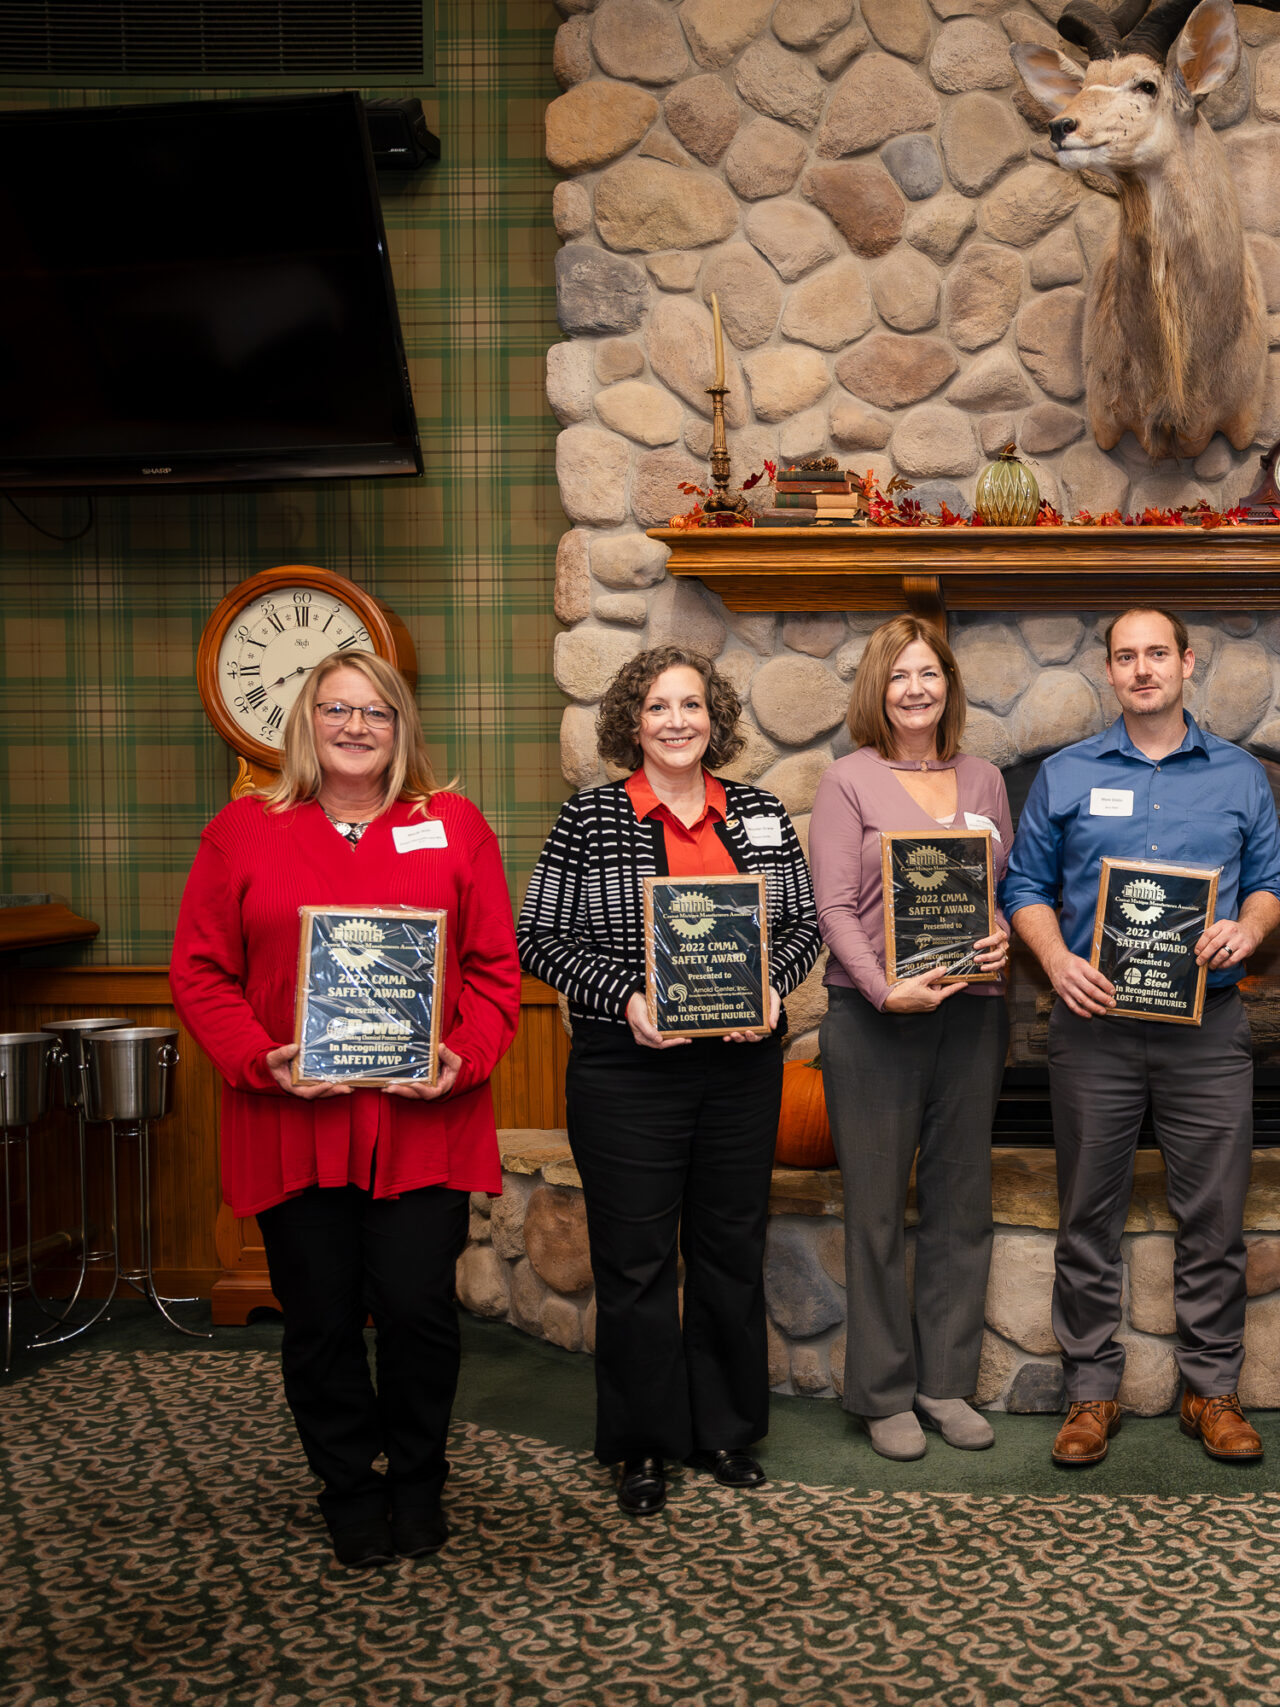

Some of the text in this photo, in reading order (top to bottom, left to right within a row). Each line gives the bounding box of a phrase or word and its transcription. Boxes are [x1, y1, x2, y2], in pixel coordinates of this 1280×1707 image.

[293, 592, 312, 604] 60
[260, 600, 275, 616] 55
[332, 603, 342, 613] 5
[234, 625, 249, 643] 50
[356, 627, 371, 642] 10
[227, 661, 238, 680] 45
[233, 696, 249, 714] 40
[259, 726, 275, 741] 35
[915, 893, 968, 904] 2022 CMMA
[909, 905, 976, 916] SAFETY AWARD
[923, 922, 954, 930] Presented
[1126, 927, 1181, 941] 2022 CMMA
[679, 941, 738, 952] 2022 CMMA
[1116, 938, 1187, 954] SAFETY AWARD
[671, 953, 747, 965] SAFETY AWARD
[1129, 956, 1161, 967] Presented
[338, 973, 407, 985] 2022 CMMA
[1144, 969, 1167, 979] Alro
[1144, 978, 1171, 989] Steel
[328, 987, 415, 999] SAFETY AWARD
[1125, 986, 1167, 998] Recognition
[1116, 993, 1187, 1008] LOST TIME INJURIES
[345, 1006, 386, 1014] Presented
[688, 1002, 734, 1012] Recognition
[680, 1014, 699, 1022] LOST
[721, 1011, 756, 1019] INJURIES
[348, 1018, 411, 1035] Powell
[329, 1043, 407, 1053] In Recognition of
[333, 1054, 402, 1065] SAFETY MVP
